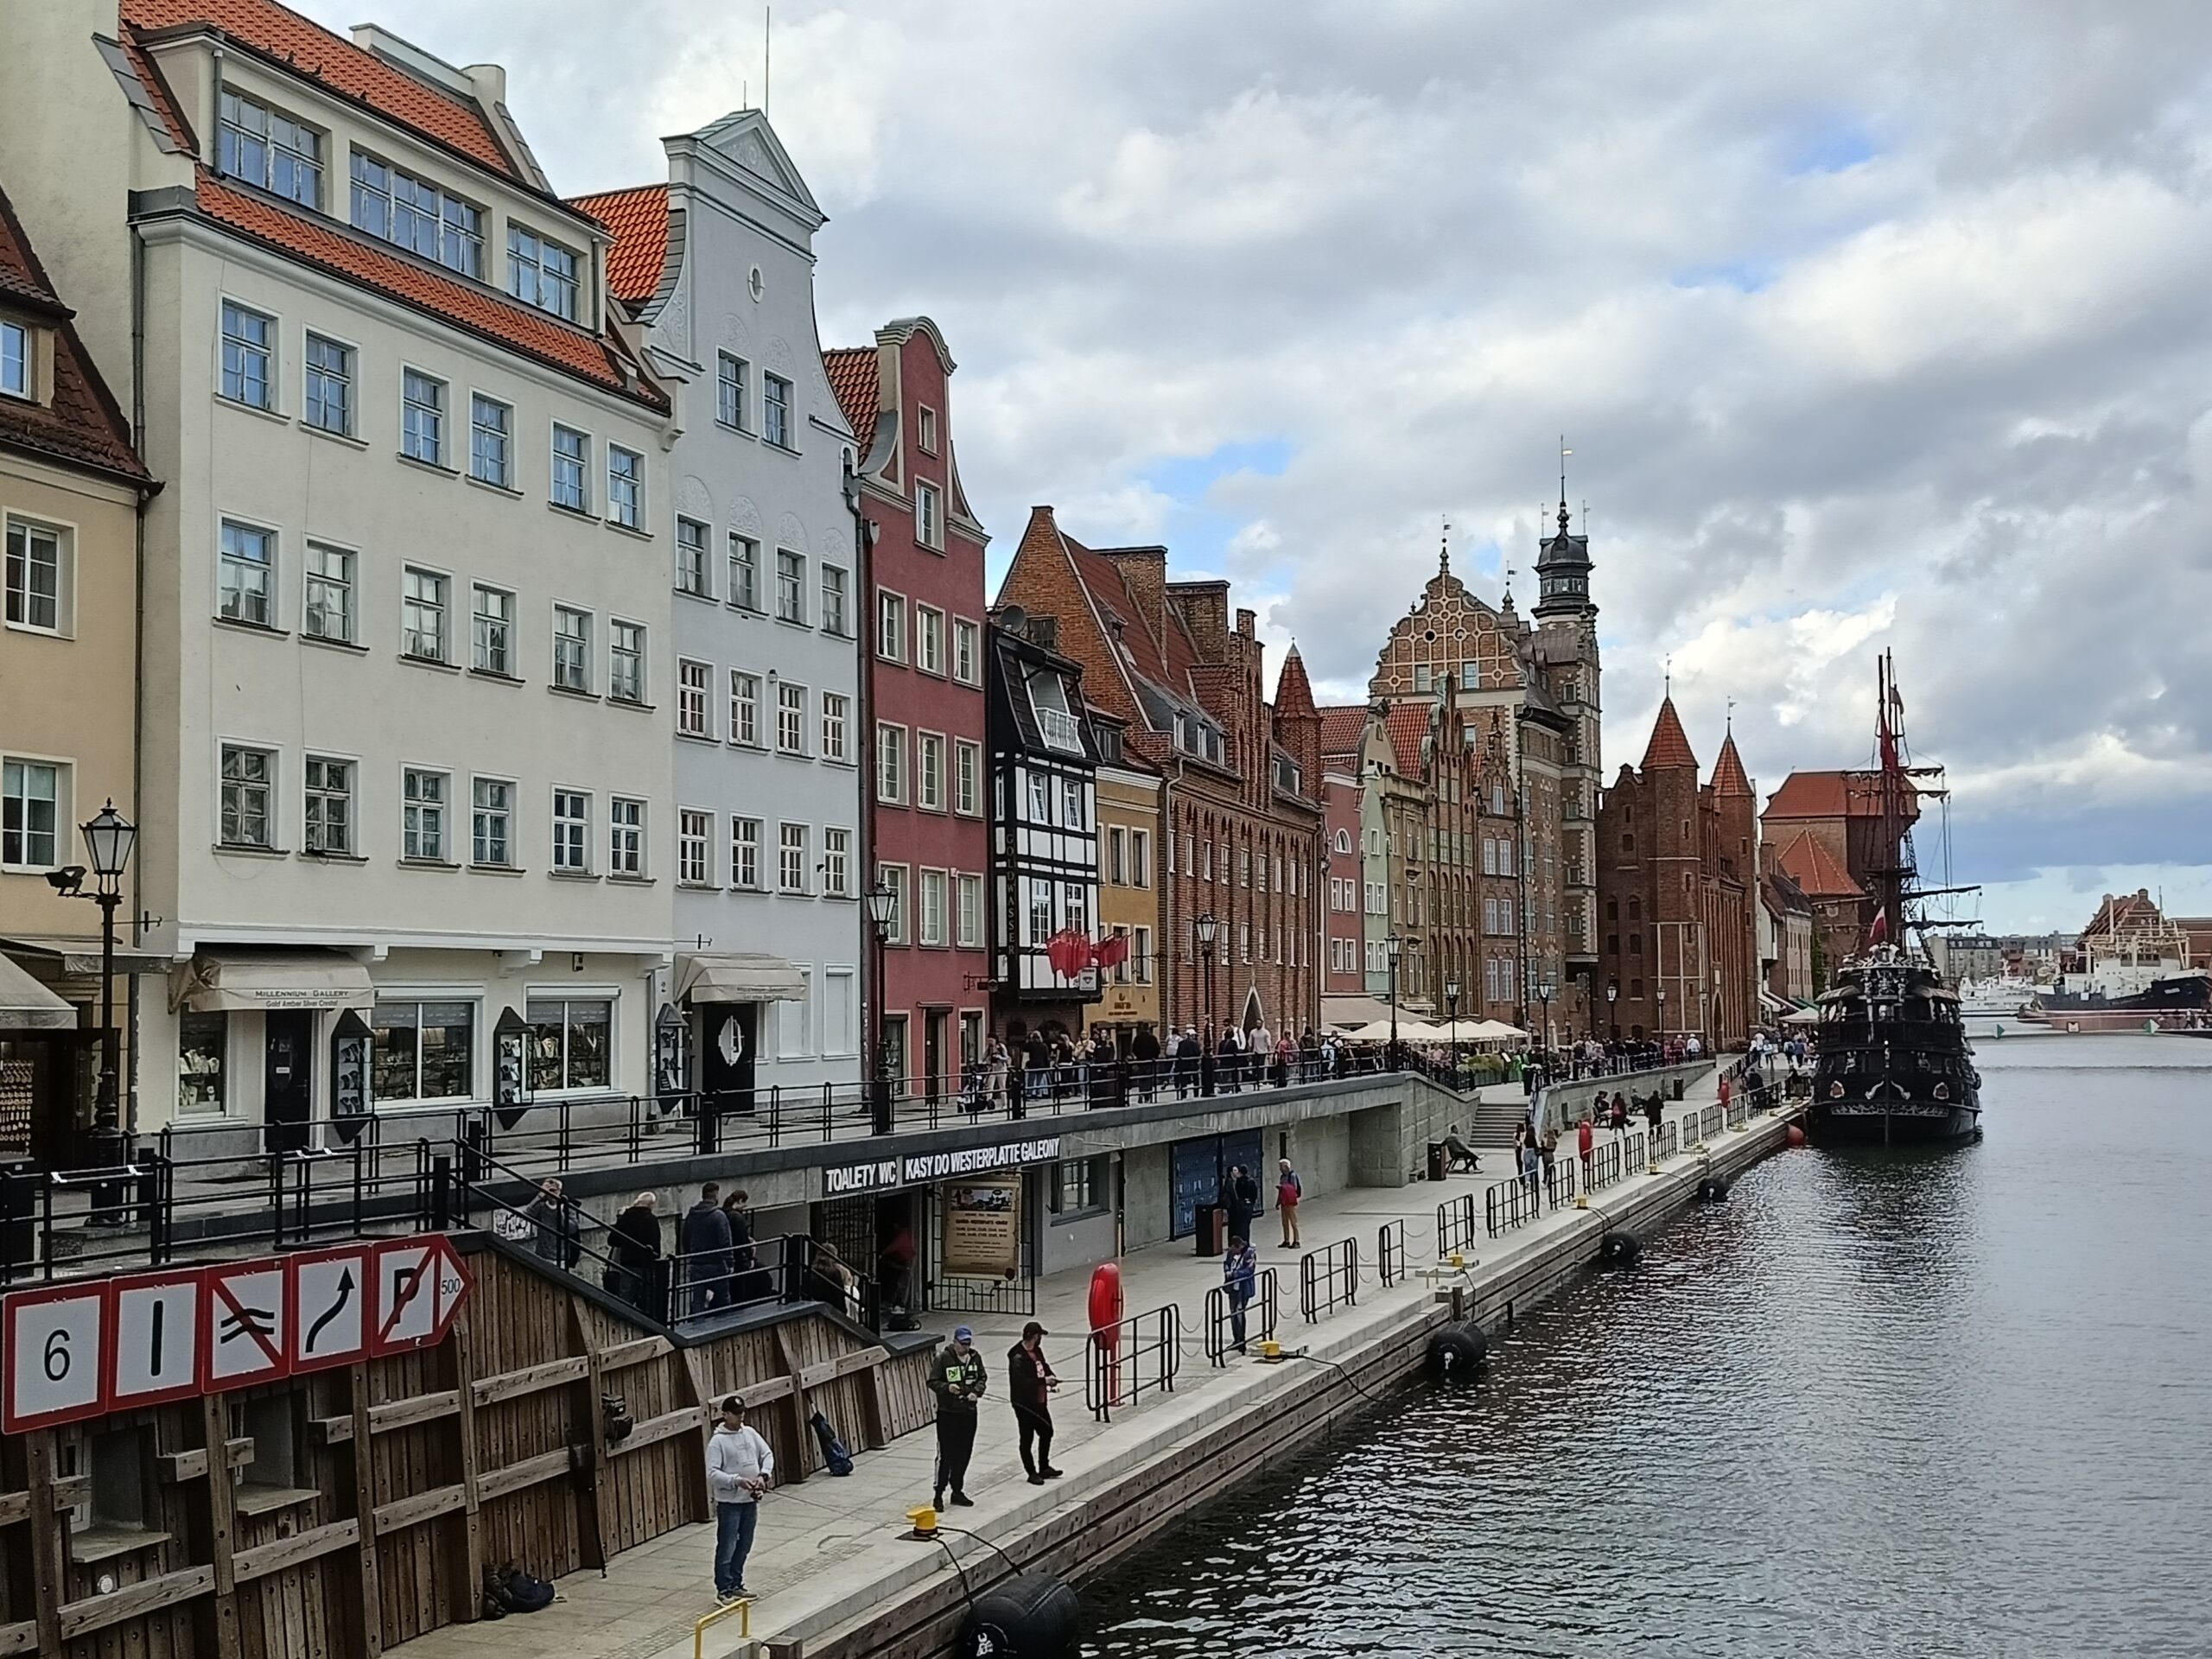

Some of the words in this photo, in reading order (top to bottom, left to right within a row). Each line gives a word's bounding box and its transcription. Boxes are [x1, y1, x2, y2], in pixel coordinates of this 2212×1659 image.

[1006, 833, 1015, 955] GOLDWASSER
[826, 1163, 876, 1192] TOALETY
[878, 1160, 897, 1185] WC
[905, 1155, 934, 1180] KASY
[934, 1154, 950, 1175] DO
[950, 1143, 1020, 1173] WESTERPLATTE
[1020, 1137, 1060, 1161] GALEONY
[441, 1277, 461, 1295] 500
[44, 1328, 71, 1382] 6
